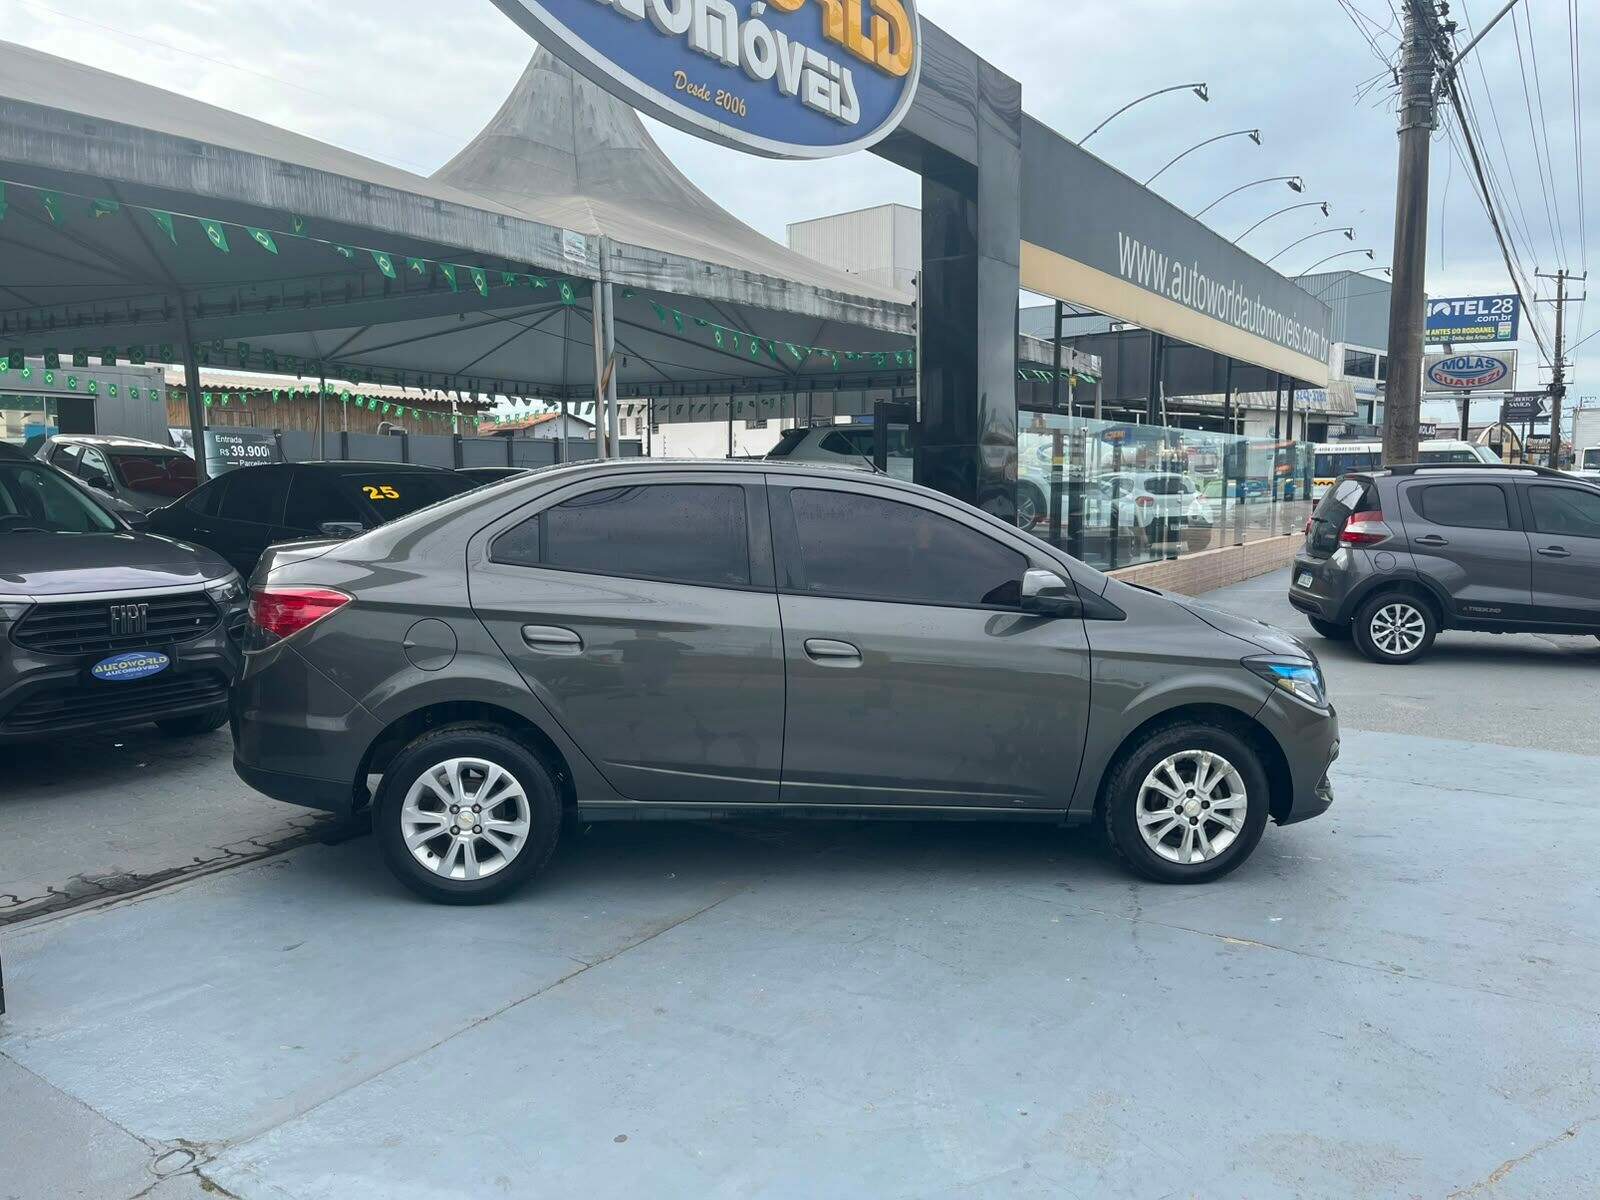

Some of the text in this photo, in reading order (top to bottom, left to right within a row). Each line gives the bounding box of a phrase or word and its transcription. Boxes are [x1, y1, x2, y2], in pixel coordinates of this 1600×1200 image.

[674, 70, 747, 117] Desde 2006
[1118, 231, 1329, 363] www.autoworldautomoveis.combr
[1490, 298, 1514, 314] 28
[1474, 313, 1512, 323] .com.br
[1431, 328, 1451, 336] ANTES
[1461, 326, 1495, 334] RODOANEL
[1442, 355, 1495, 370] MOLAS
[1434, 369, 1500, 386] GUAREZI
[215, 434, 243, 445] Entrada
[219, 448, 230, 457] R$
[362, 485, 400, 500] 25
[110, 603, 149, 634] FIAT
[95, 656, 168, 673] AUTOWORLD
